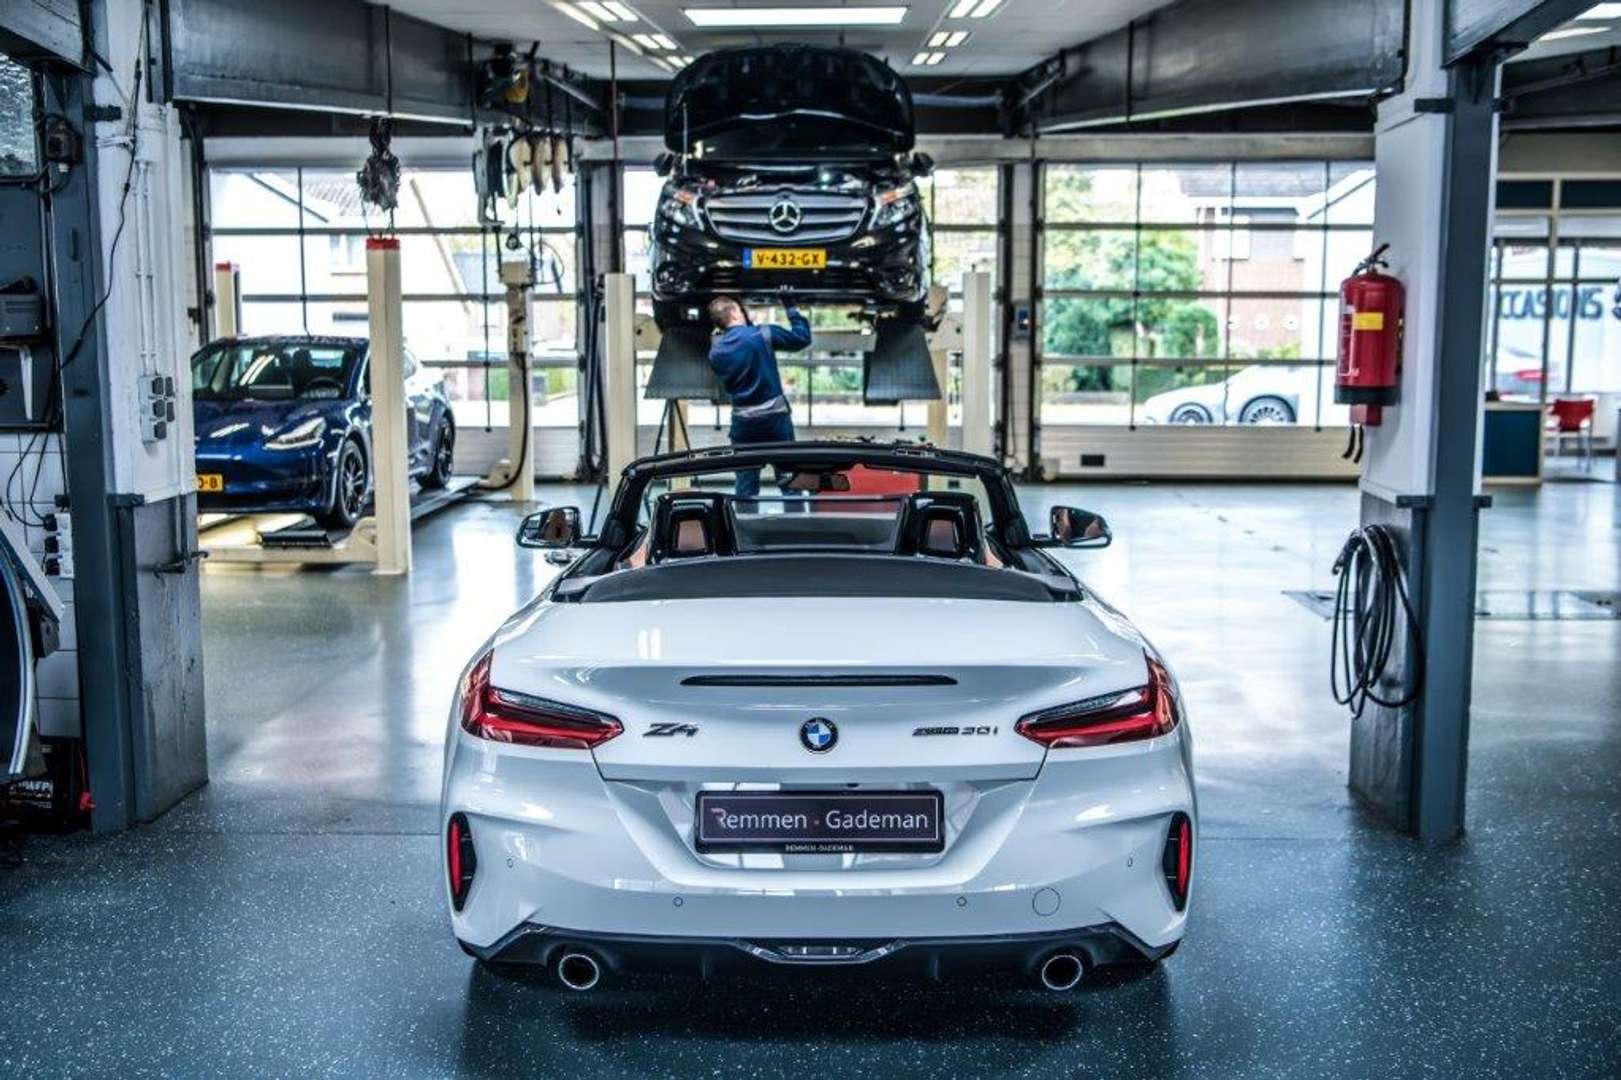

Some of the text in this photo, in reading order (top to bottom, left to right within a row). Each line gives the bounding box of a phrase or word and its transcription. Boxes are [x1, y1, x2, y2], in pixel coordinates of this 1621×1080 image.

[756, 252, 820, 266] V-432-GX
[642, 722, 699, 737] Z4
[710, 807, 929, 829] Remmen Gademan
